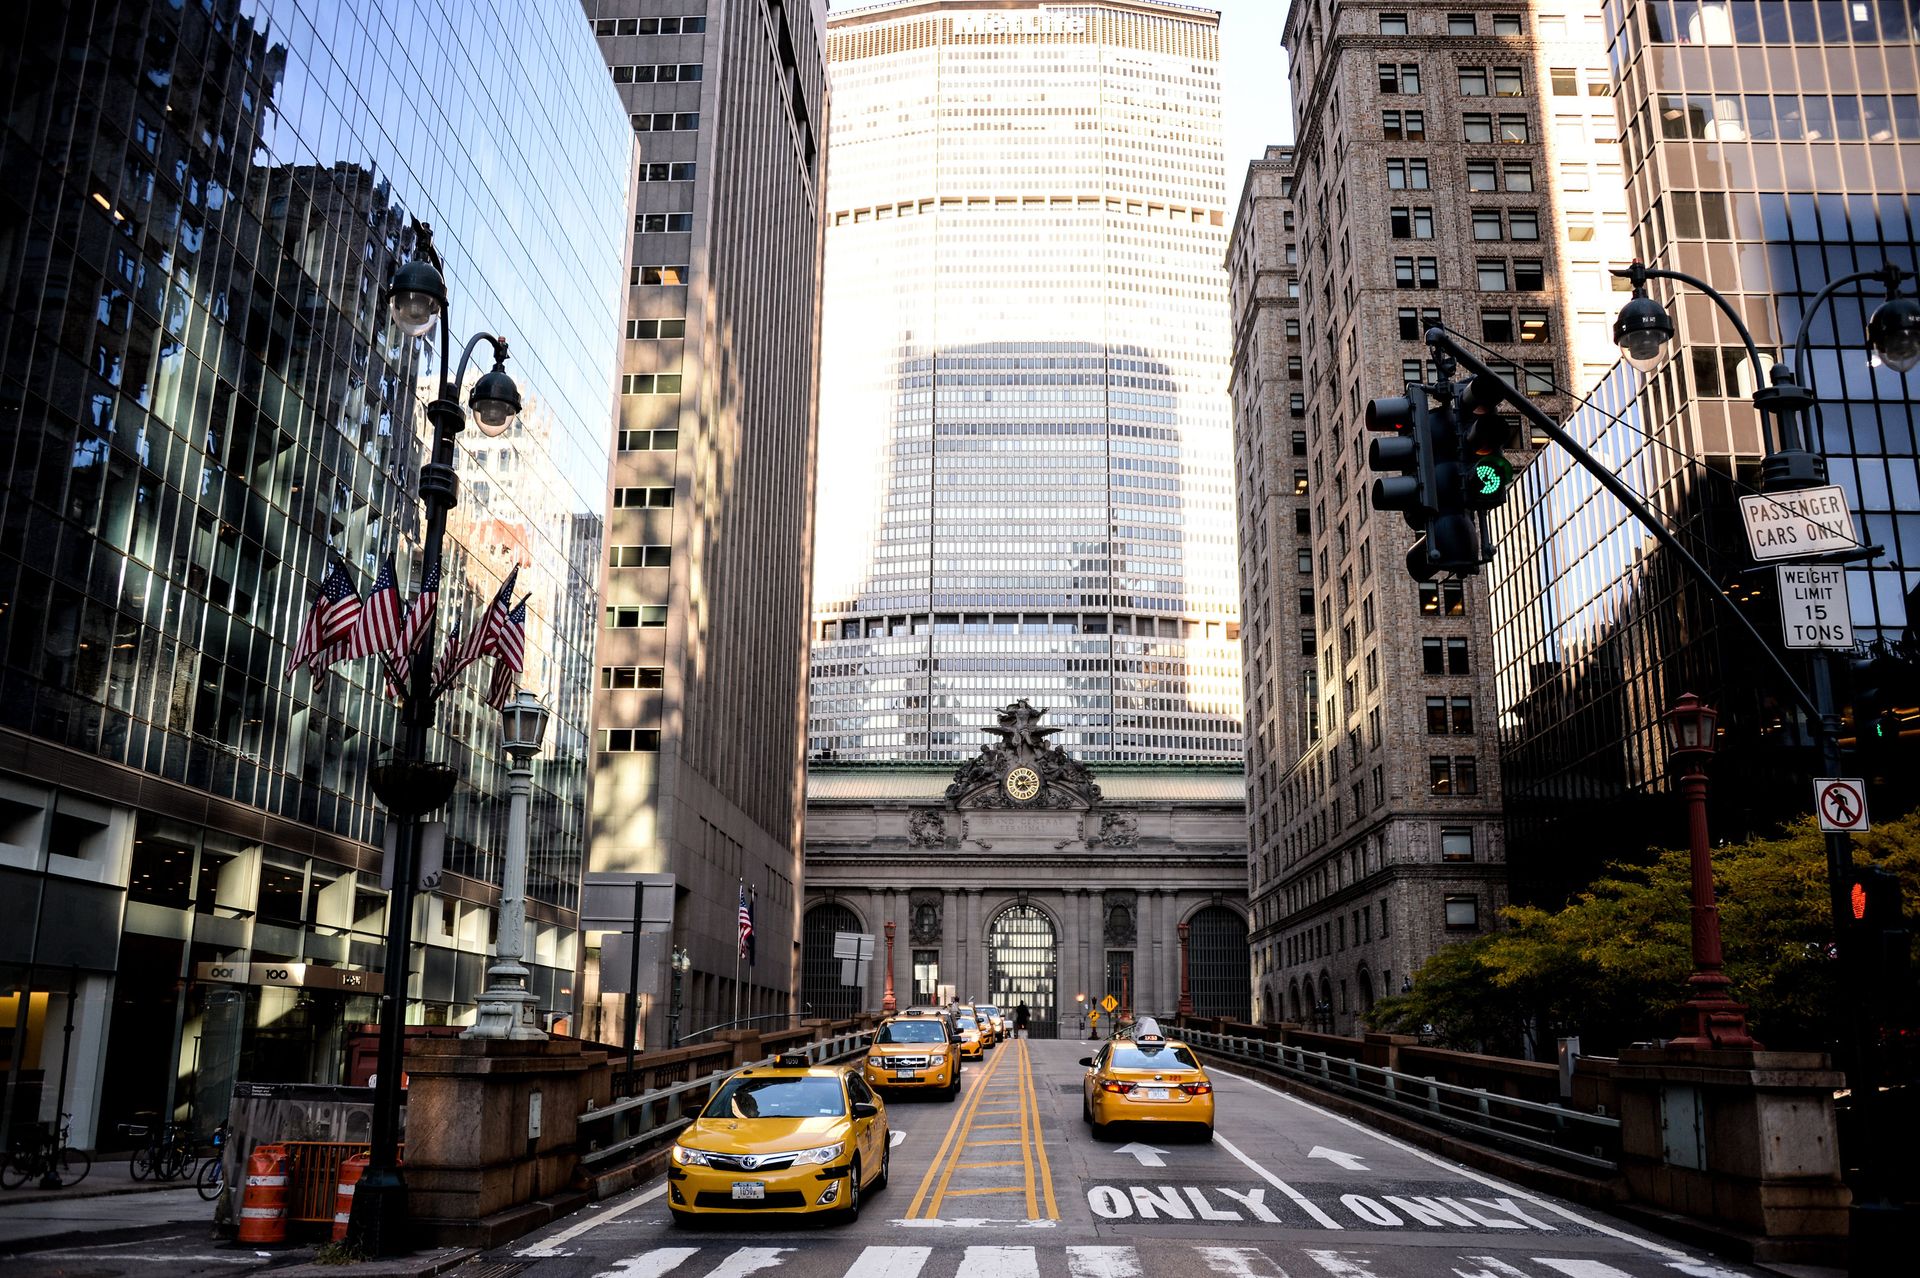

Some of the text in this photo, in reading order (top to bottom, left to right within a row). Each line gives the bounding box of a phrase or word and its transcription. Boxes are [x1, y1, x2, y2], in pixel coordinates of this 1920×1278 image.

[1749, 496, 1840, 523] PASSENGER
[1756, 519, 1845, 547] CARS ONLY
[1785, 571, 1839, 583] WEIGHT
[1795, 587, 1833, 600] LIMIT
[1805, 605, 1828, 620] 15
[1794, 625, 1845, 641] TONS
[265, 969, 288, 980] 100
[1087, 1185, 1282, 1223] ONLY
[1339, 1193, 1559, 1231] ONLY
